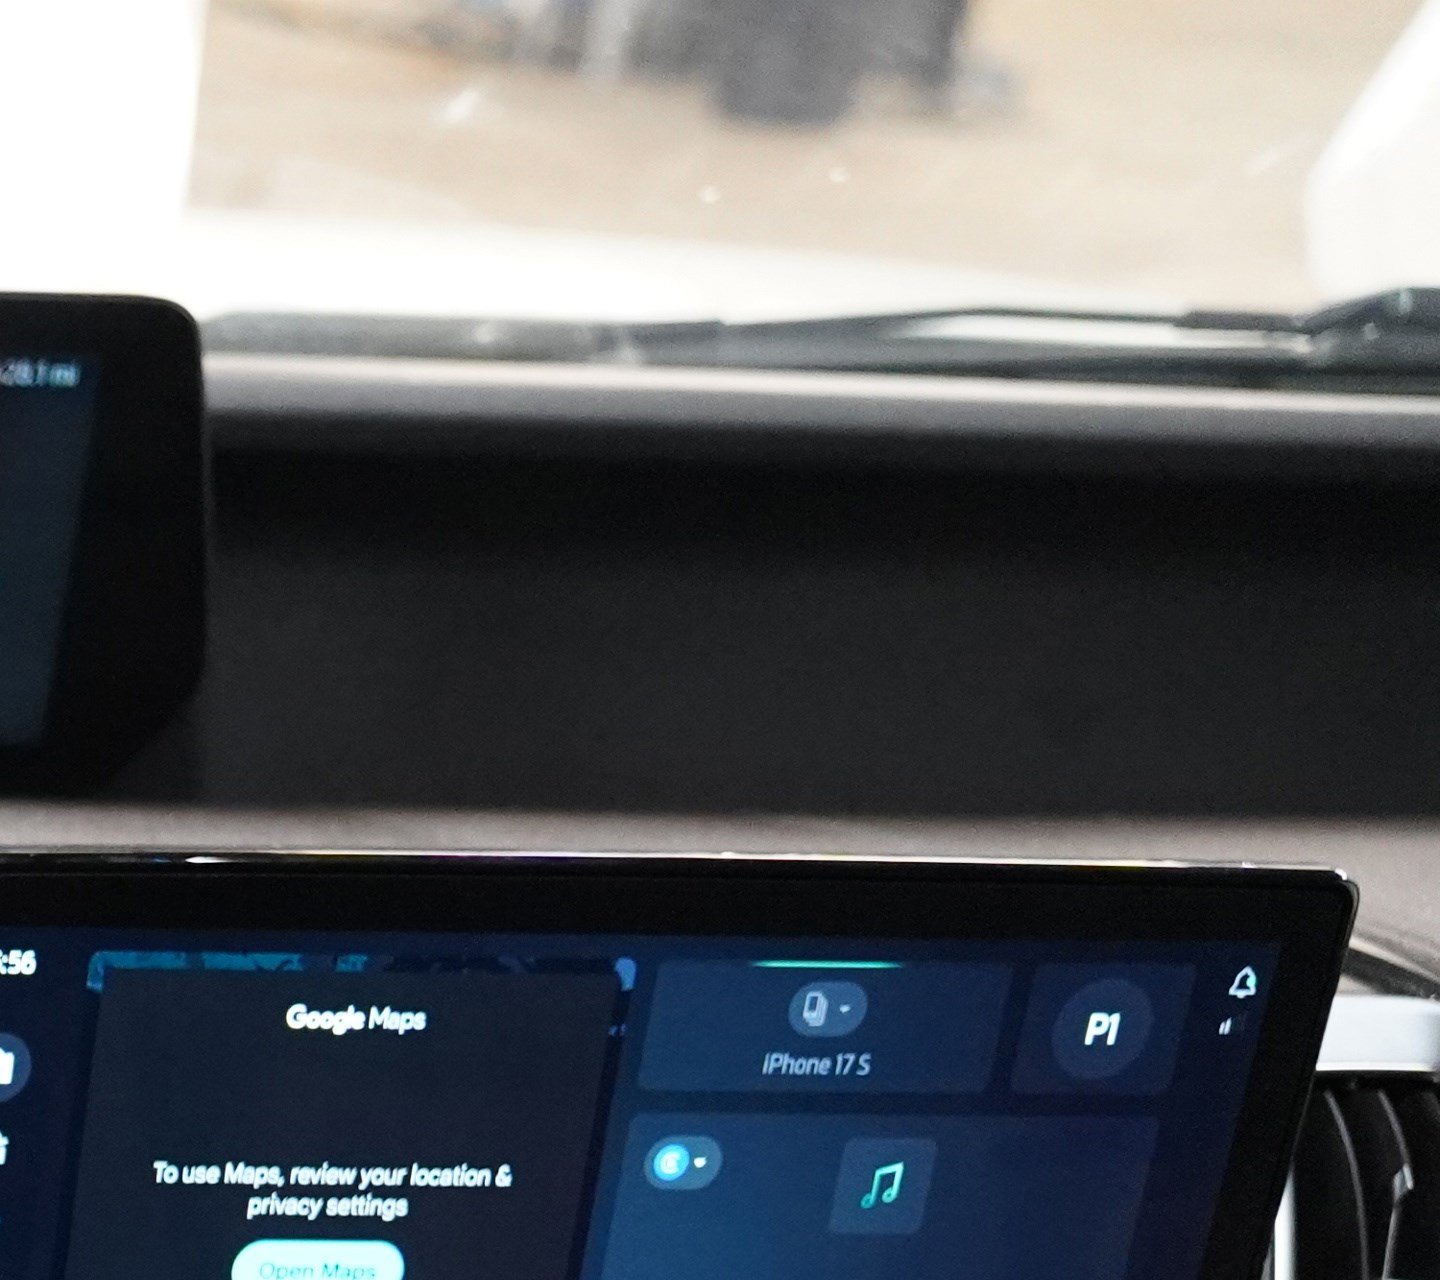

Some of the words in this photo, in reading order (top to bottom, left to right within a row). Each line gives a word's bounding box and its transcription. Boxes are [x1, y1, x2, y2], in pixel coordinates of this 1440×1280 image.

[285, 1003, 365, 1036] Google
[368, 1006, 427, 1035] Maps
[1084, 1011, 1121, 1046] P1
[762, 1052, 831, 1076] iPhone
[835, 1053, 857, 1076] 17
[857, 1053, 872, 1076] S
[153, 1160, 179, 1184] To
[182, 1164, 220, 1185] use
[223, 1161, 284, 1190] Maps,
[289, 1161, 357, 1186] review
[357, 1164, 407, 1191] your
[410, 1162, 492, 1187] location
[494, 1164, 513, 1188] &
[246, 1191, 324, 1221] privacy
[325, 1192, 409, 1222] settings
